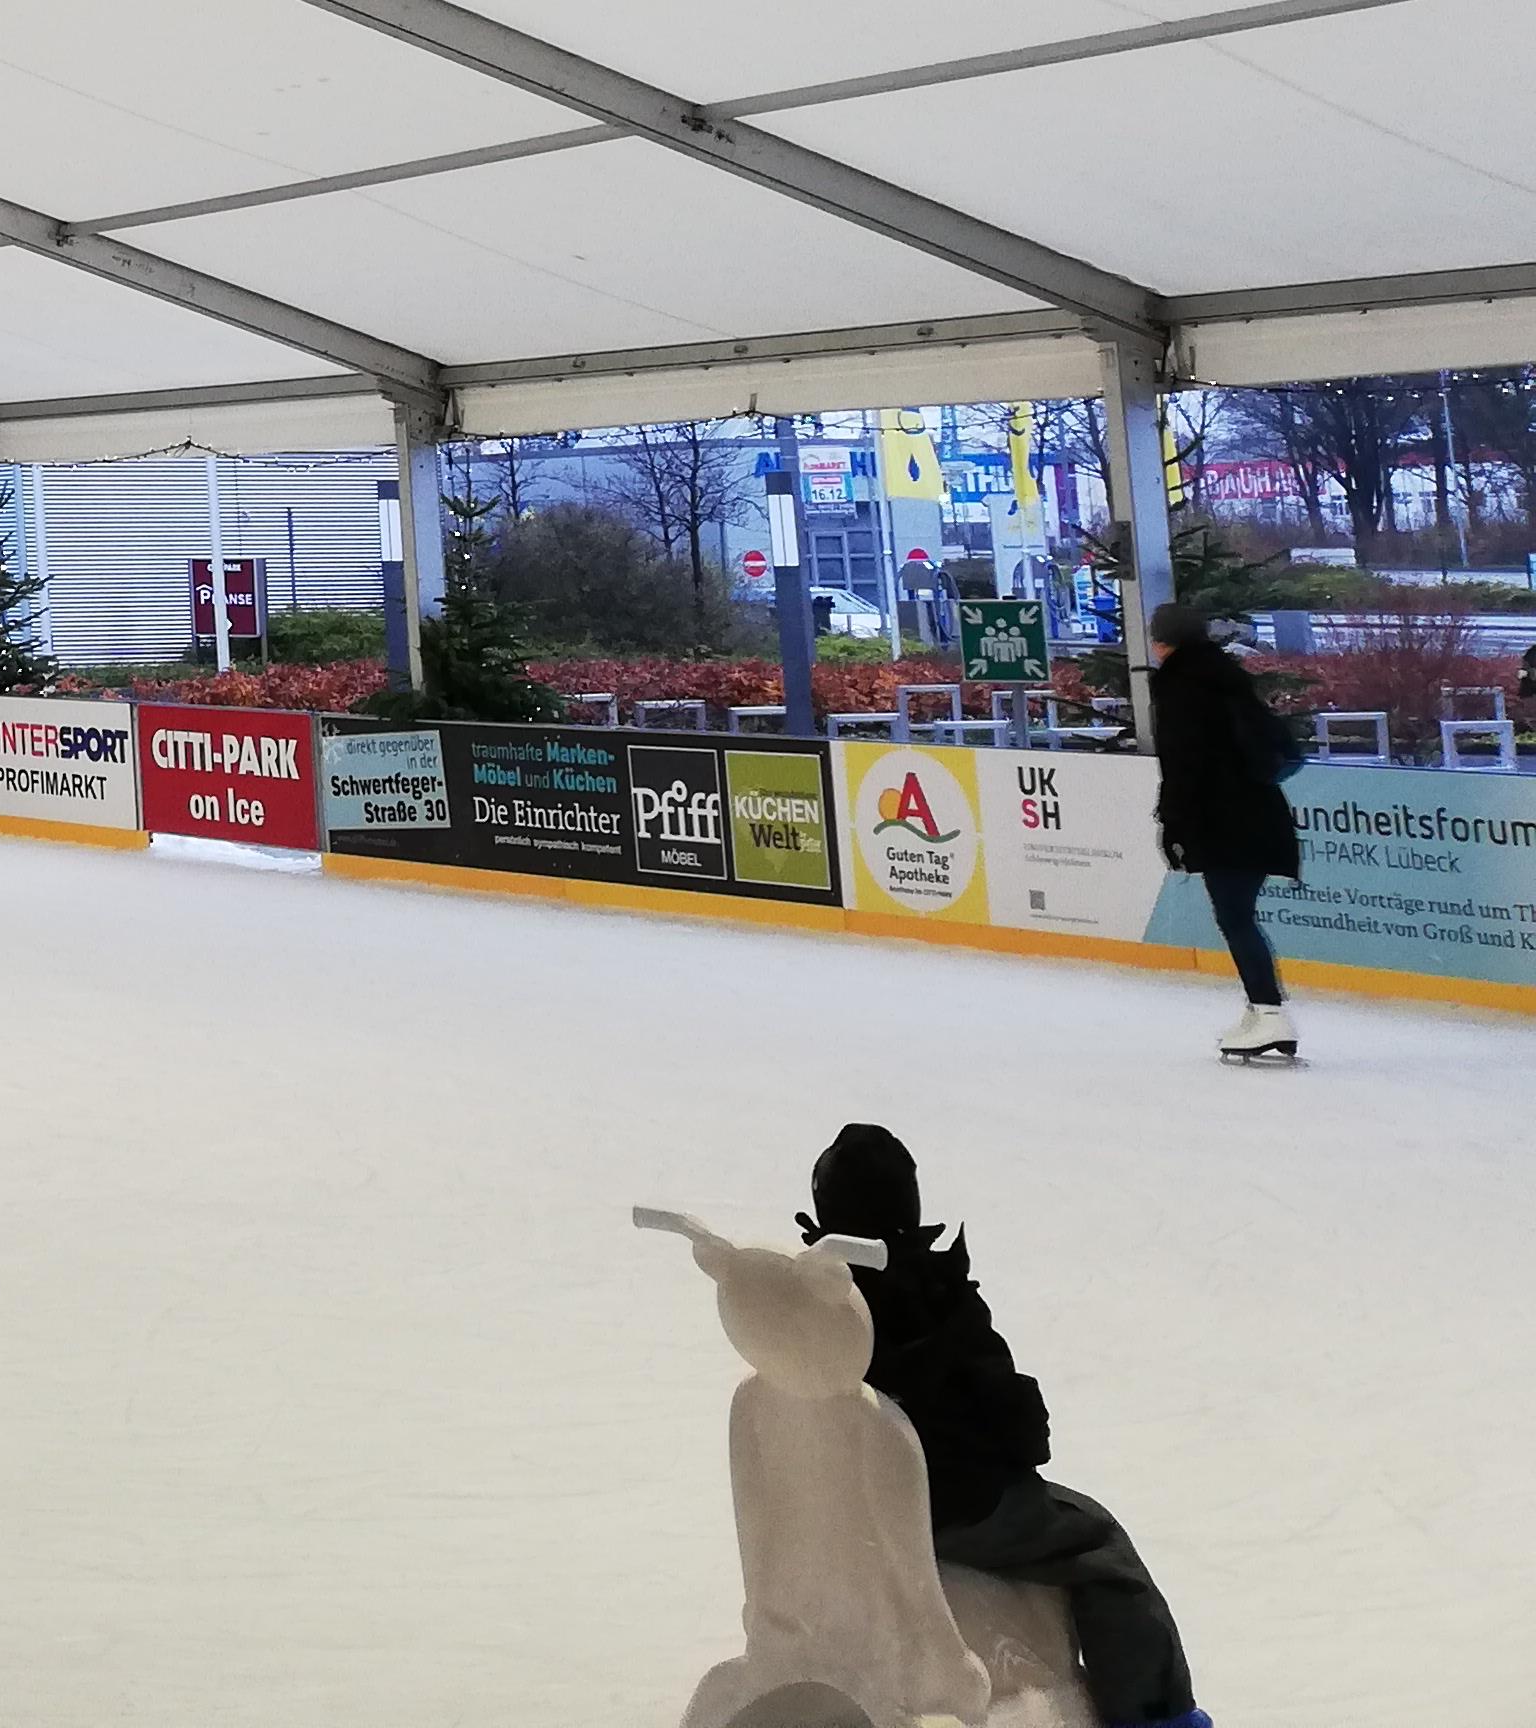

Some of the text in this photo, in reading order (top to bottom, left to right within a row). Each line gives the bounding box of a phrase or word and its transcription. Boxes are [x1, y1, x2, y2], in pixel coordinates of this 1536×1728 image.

[151, 728, 301, 780] CITTI-PARK
[346, 735, 435, 758] direkt gegenüber
[419, 754, 439, 769] der
[471, 741, 616, 766] traumhafte Marken-
[330, 772, 444, 801] Schwertfeger-
[473, 762, 618, 794] Möbel und Küchen
[1017, 766, 1059, 798] UK
[189, 788, 265, 826] on Ice
[363, 799, 447, 824] Straße 30
[472, 796, 621, 836] Die Einrichter
[632, 780, 722, 845] Pfiff
[734, 790, 820, 824] KÜCHEN
[1021, 798, 1061, 830] SH
[749, 823, 801, 851] Welt
[661, 849, 703, 867] MÖBEL
[886, 846, 925, 865] Guten
[1385, 844, 1463, 873] Lübeck
[889, 865, 950, 886] Apotheke
[1344, 888, 1431, 916] Vorträge
[1429, 898, 1476, 917] rund
[1477, 904, 1512, 921] um
[1278, 908, 1382, 934] Gesundheit
[1386, 922, 1419, 939] von
[1423, 922, 1473, 945] Groß
[1477, 929, 1516, 949] und
